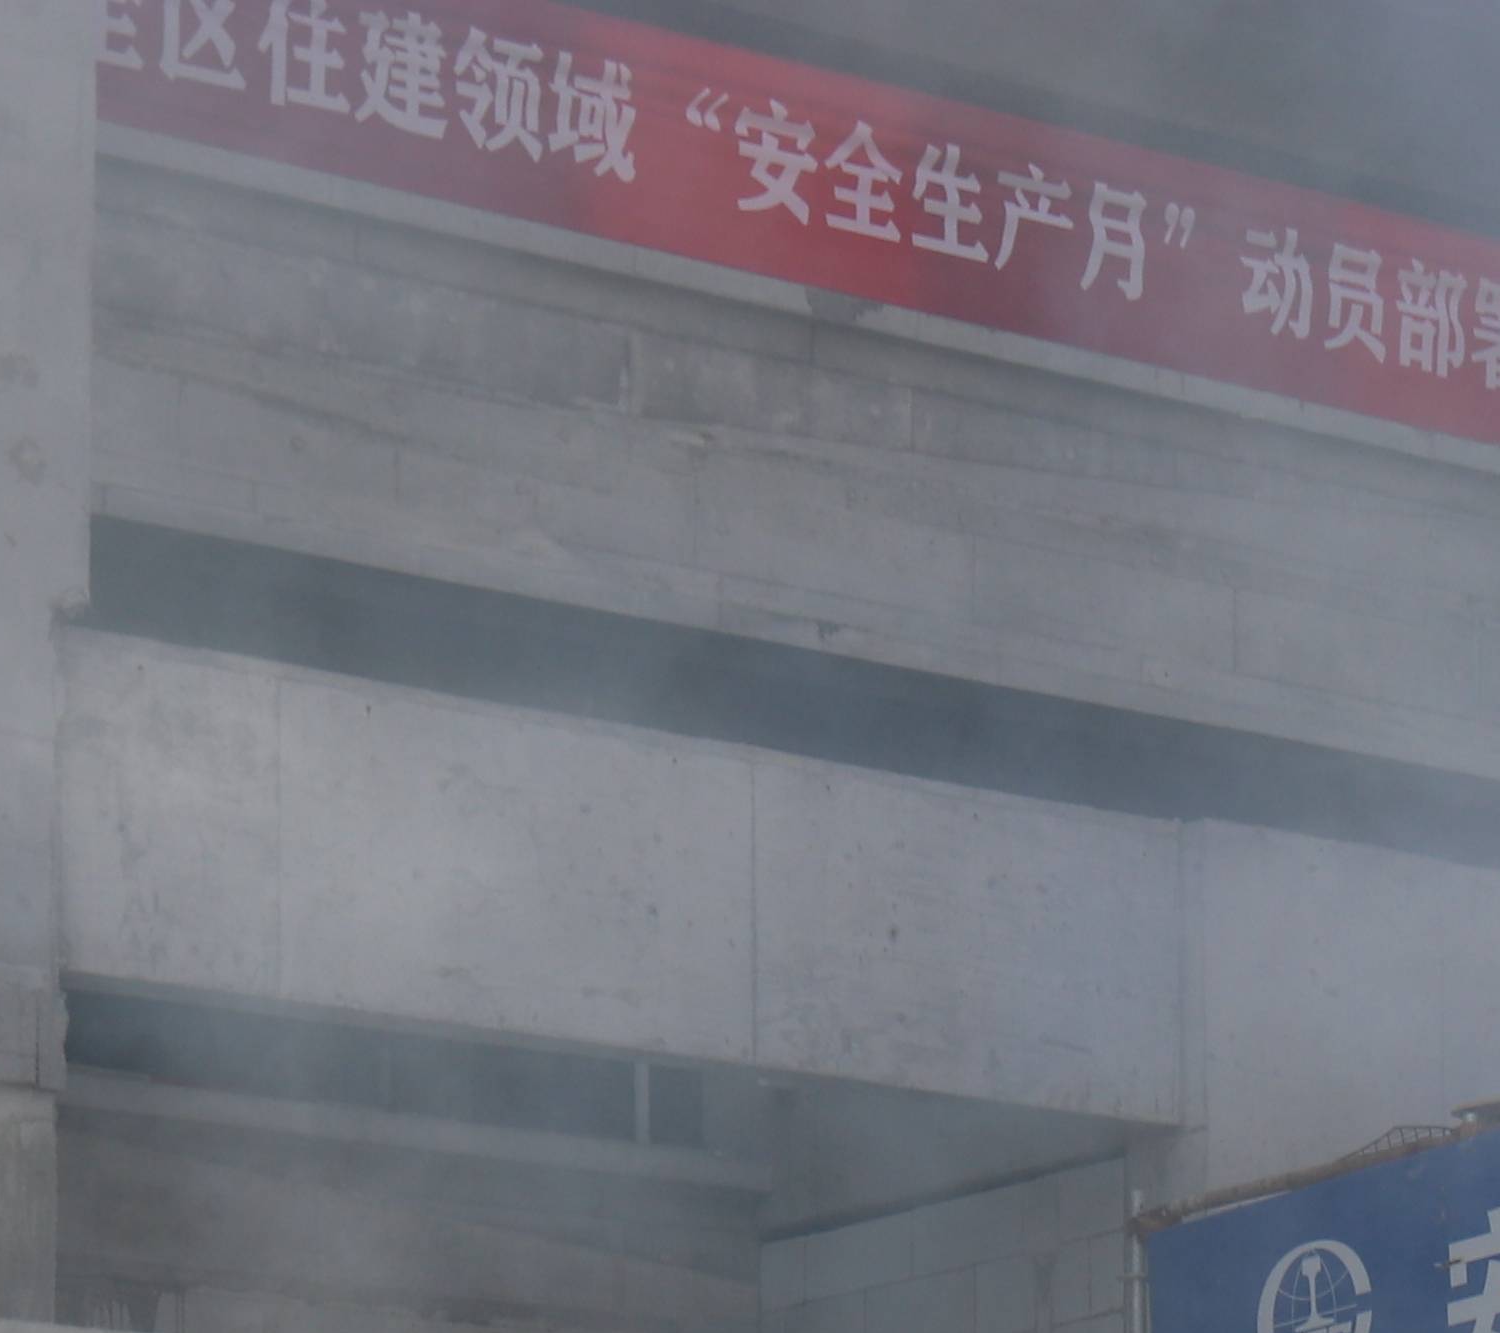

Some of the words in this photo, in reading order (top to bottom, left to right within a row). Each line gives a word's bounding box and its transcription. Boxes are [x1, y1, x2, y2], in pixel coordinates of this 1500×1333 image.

[684, 86, 1197, 303] “安全生产月”
